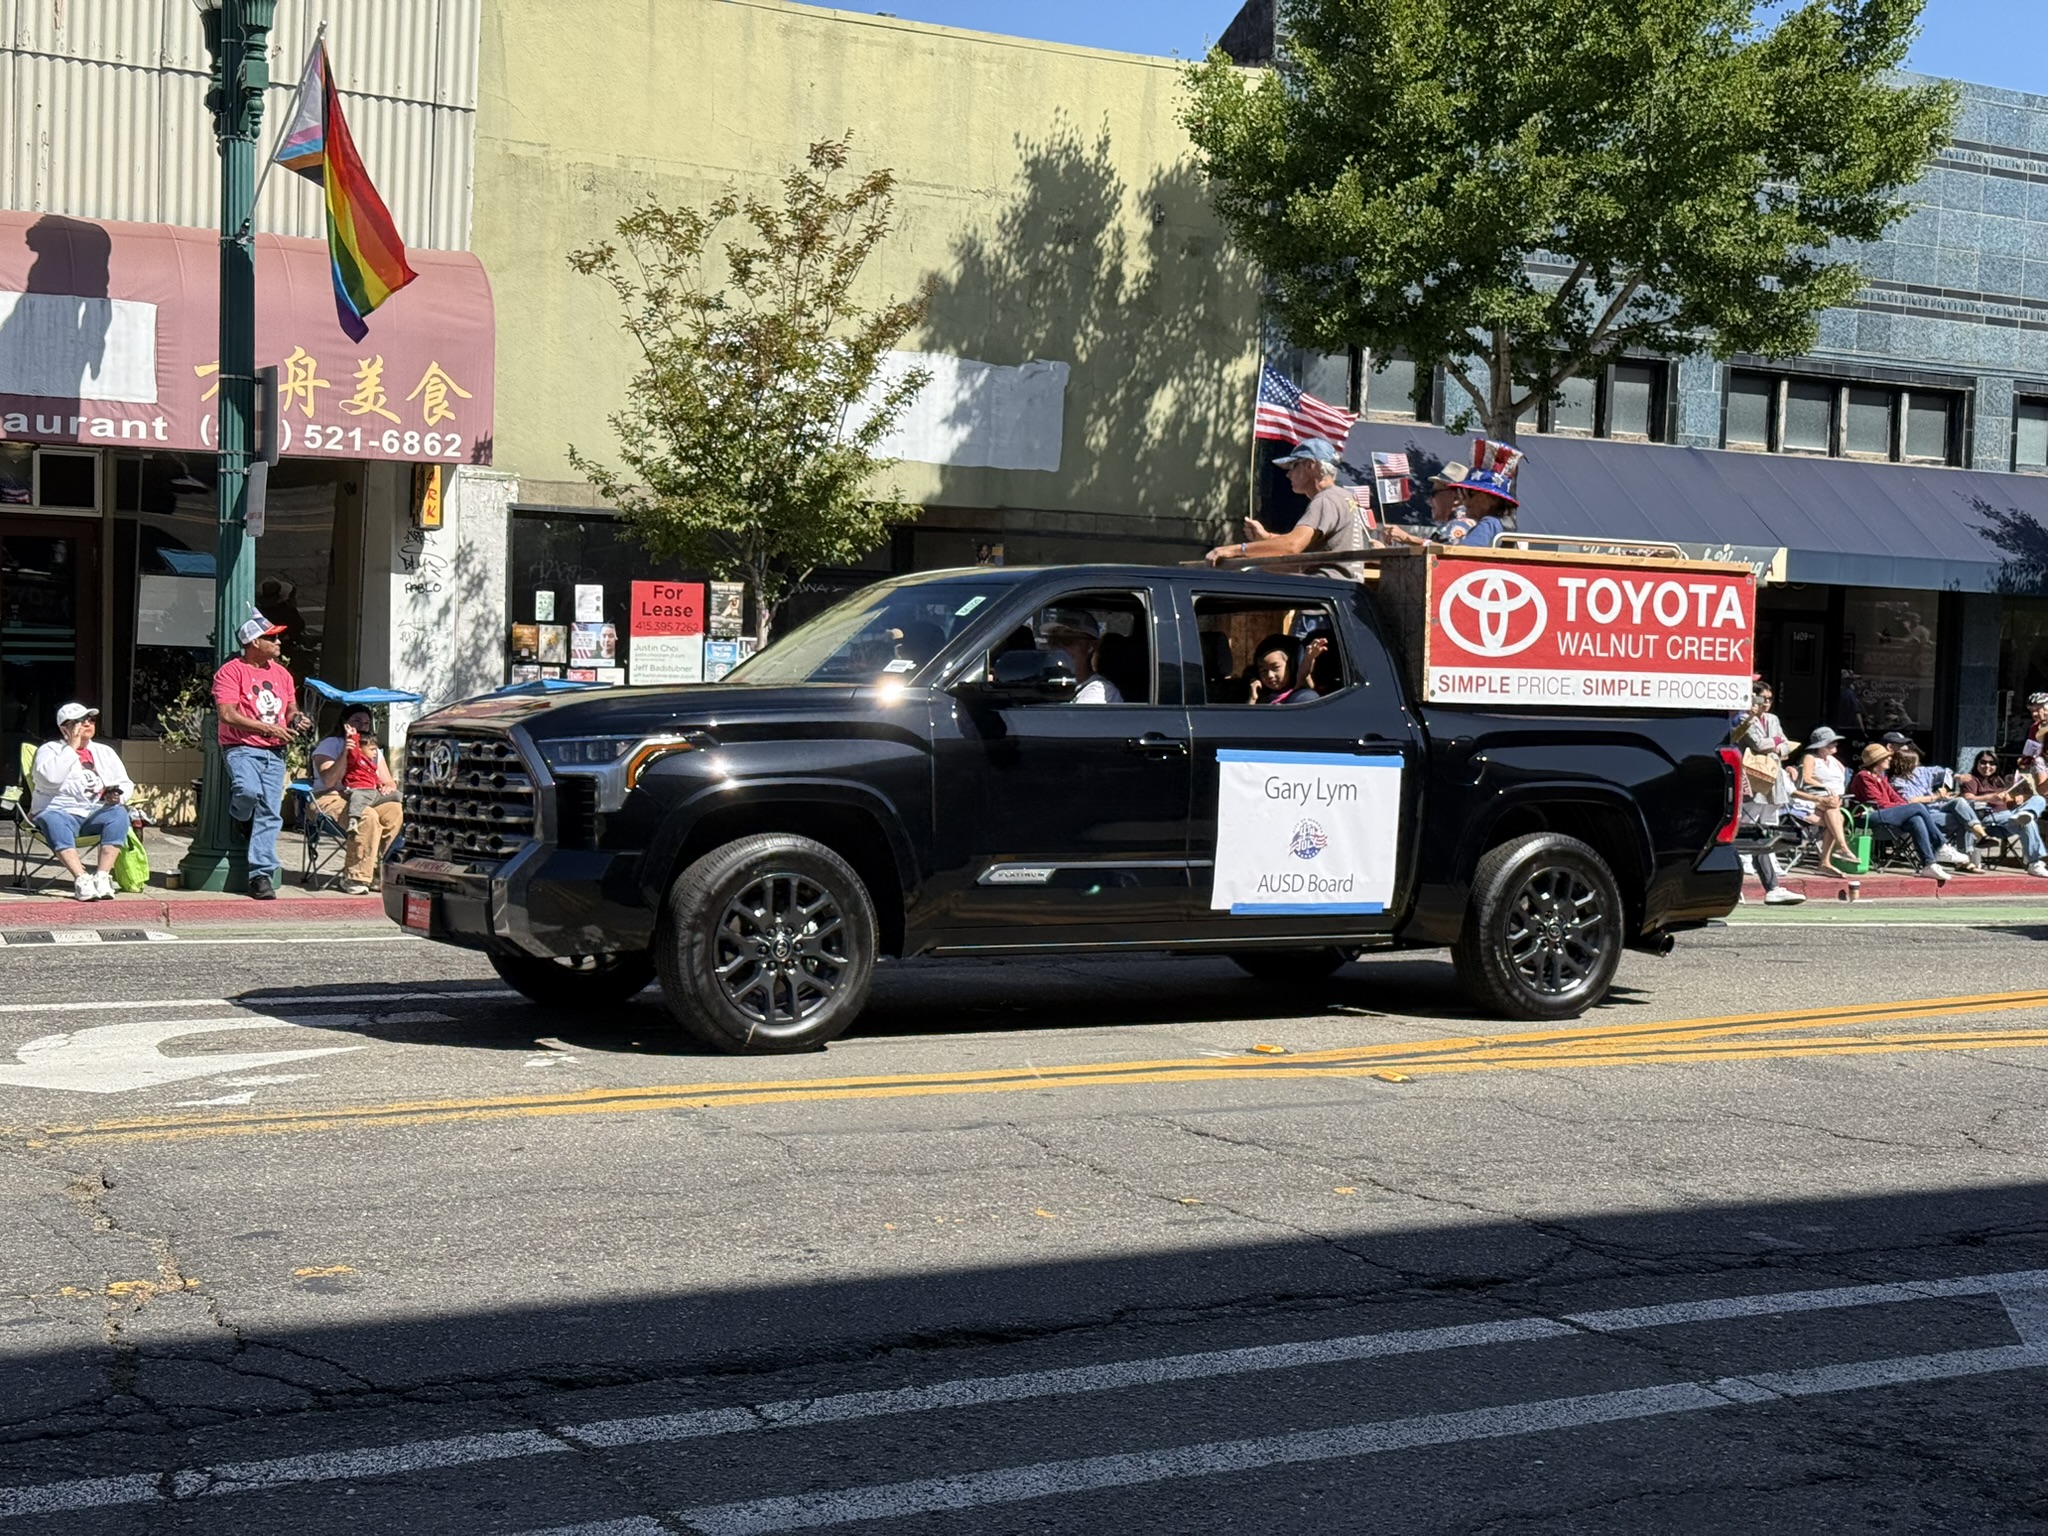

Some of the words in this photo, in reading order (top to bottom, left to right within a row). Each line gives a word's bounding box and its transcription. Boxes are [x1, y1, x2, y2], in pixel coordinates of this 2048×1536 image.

[304, 424, 463, 458] 521-6862
[653, 585, 683, 600] For
[1557, 576, 1746, 630] TOYOTA
[642, 602, 693, 618] Lease
[1557, 631, 1660, 659] WALNUT
[1666, 635, 1745, 663] CREEK
[1438, 674, 1511, 694] SIMPLE
[1517, 676, 1576, 696] PRICE.
[1582, 677, 1652, 697] SIMPLE
[1657, 679, 1744, 701] PROCESS.
[1264, 776, 1312, 806] Gary
[1317, 777, 1358, 807] Lym
[1257, 873, 1304, 893] AUSD
[1308, 873, 1354, 893] Board
